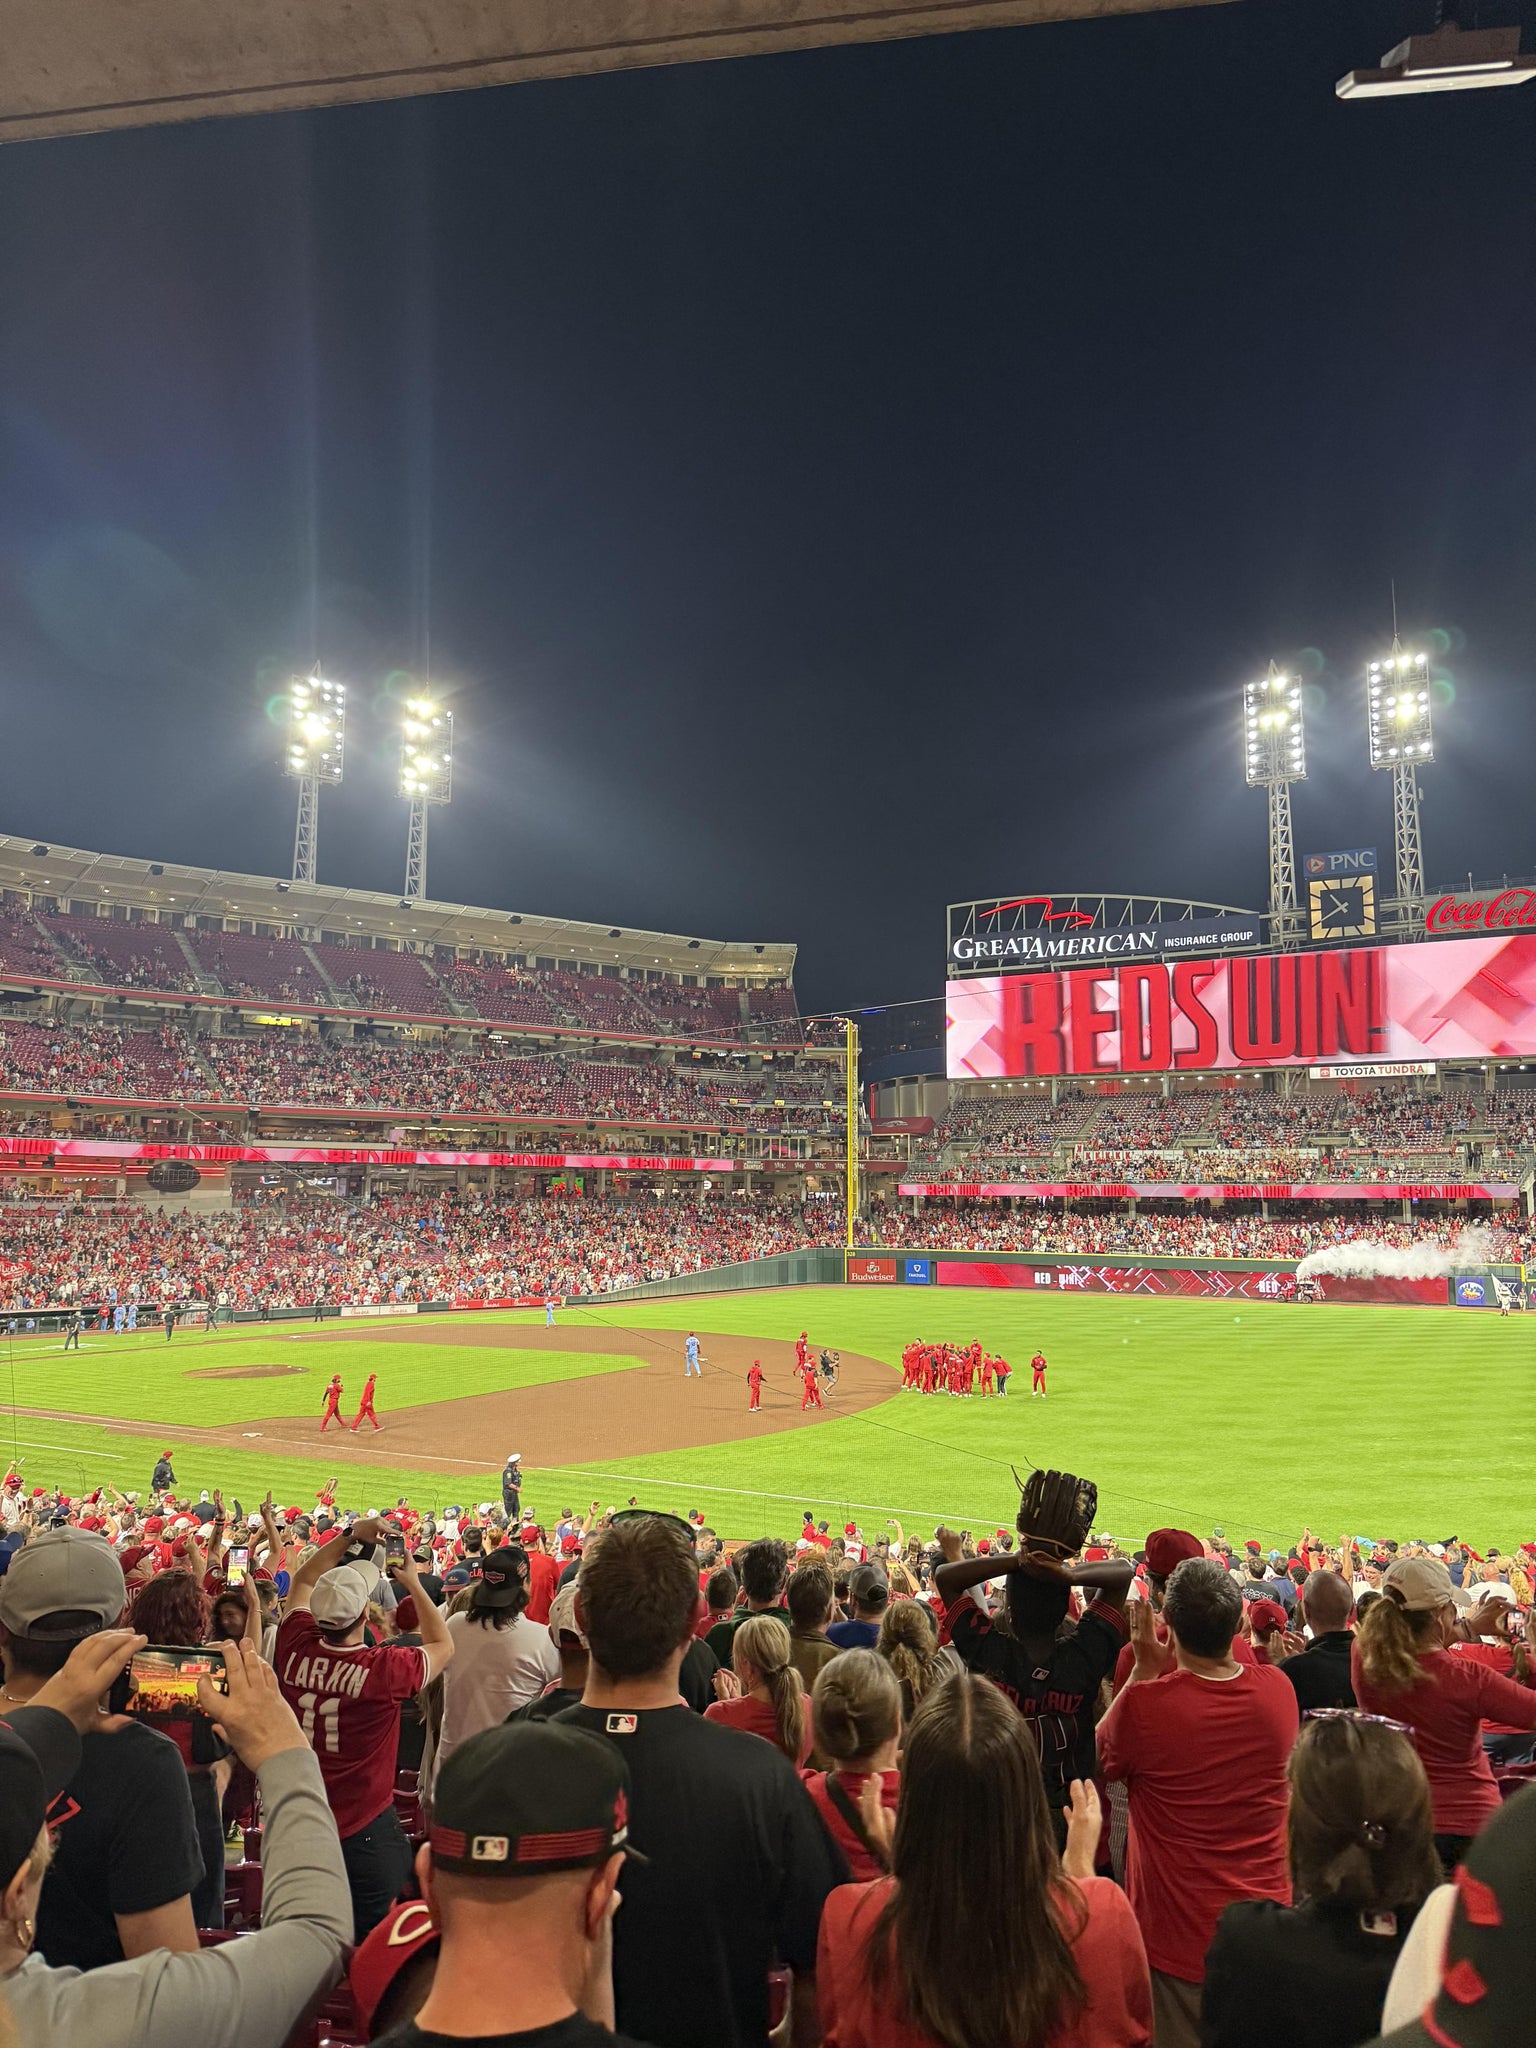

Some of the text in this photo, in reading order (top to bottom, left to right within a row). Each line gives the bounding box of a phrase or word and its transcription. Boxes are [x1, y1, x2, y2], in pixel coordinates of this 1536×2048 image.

[1328, 851, 1374, 870] PNC
[1164, 931, 1254, 948] INSURANCE GROUP
[1001, 960, 1218, 1075] REDS
[1334, 1065, 1424, 1076] TOYOTA TUNDRA
[851, 1273, 894, 1281] Budweiser
[283, 1651, 371, 1699] LARKIN
[298, 1692, 341, 1753] 11
[387, 1904, 433, 1946] C
